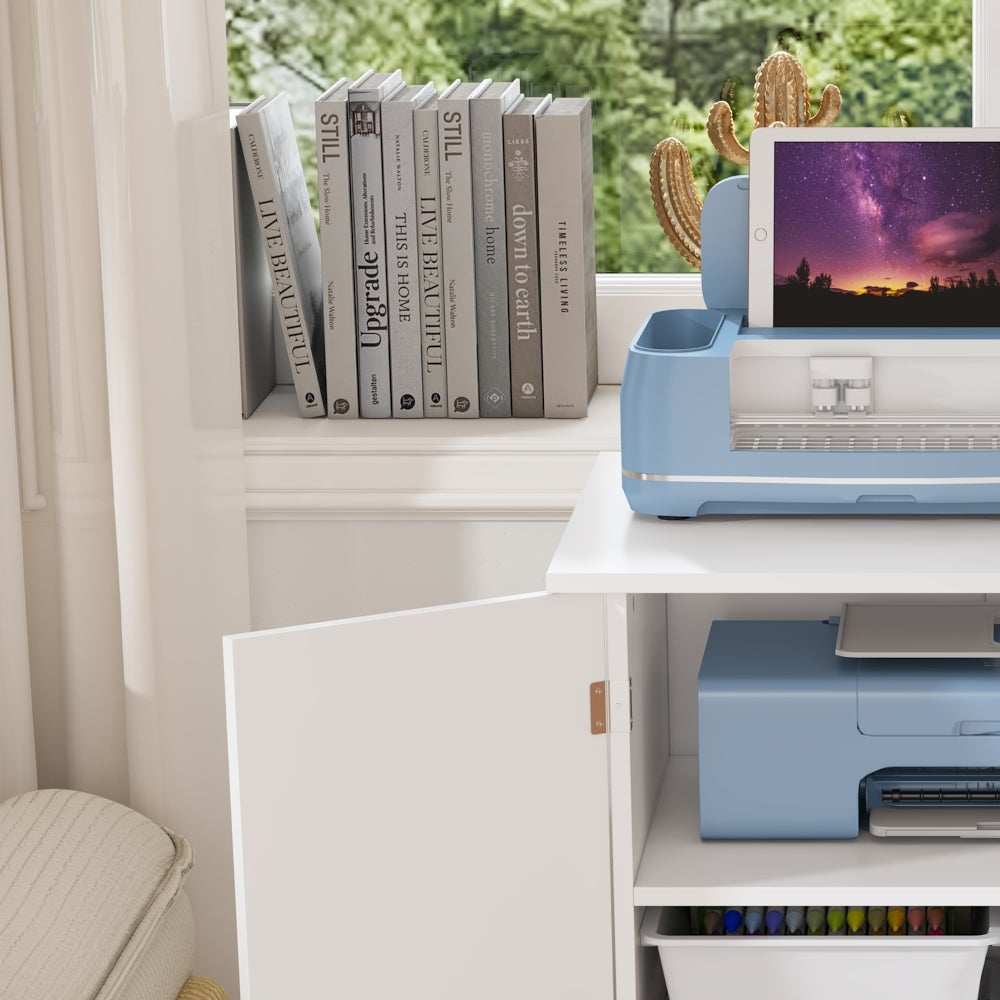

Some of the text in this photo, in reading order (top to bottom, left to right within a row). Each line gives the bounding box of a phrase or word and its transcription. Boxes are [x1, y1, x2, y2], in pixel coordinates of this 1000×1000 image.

[248, 133, 264, 180] CALDERONE
[321, 113, 340, 163] STILL
[422, 129, 430, 176] CALDERONE
[443, 111, 463, 162] STILL
[482, 132, 500, 265] monochrome home
[258, 198, 310, 374] LIVE BEAUTIFUL
[358, 251, 388, 348] Upgrade
[396, 212, 410, 322] THIS IS HOME
[420, 196, 442, 374] LIVE BEAUTIFUL
[512, 204, 538, 340] down to earth
[558, 221, 569, 313] TIMELESS LIVING
[370, 374, 378, 405] gestalten
